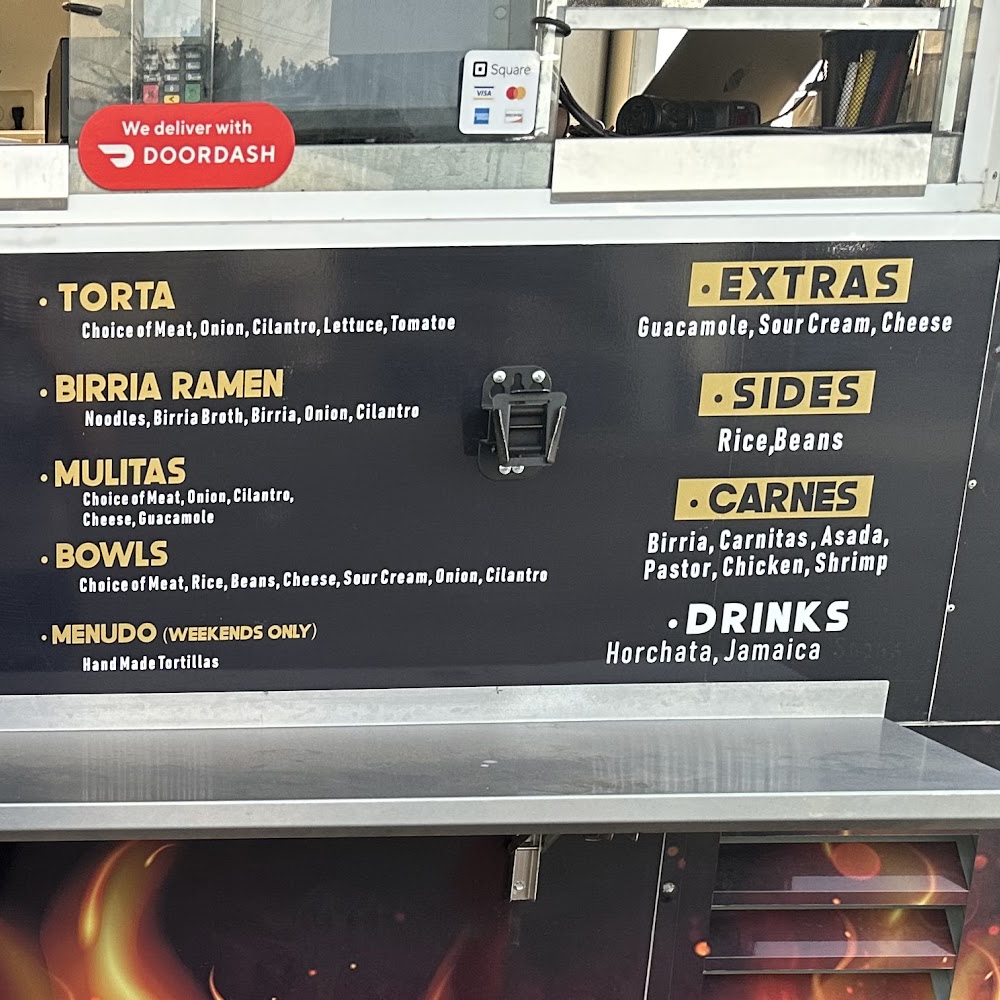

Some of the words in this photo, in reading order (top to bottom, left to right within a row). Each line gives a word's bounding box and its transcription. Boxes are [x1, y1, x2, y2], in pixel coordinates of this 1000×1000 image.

[491, 64, 531, 78] Square
[122, 121, 150, 135] We
[154, 121, 212, 135] deliver
[216, 120, 251, 134] with
[144, 146, 274, 164] DOORDASH
[720, 265, 898, 300] EXTRAS
[59, 281, 175, 311] TORTA
[82, 322, 133, 338] Choice
[137, 321, 152, 338] of
[391, 315, 455, 331] Tomatoe
[759, 314, 804, 334] Sour
[882, 311, 952, 332] Cheese
[56, 373, 161, 402] BIRRIA
[172, 369, 283, 399] RAMEN
[733, 376, 859, 409] SIDES
[154, 409, 198, 425] Birria
[357, 404, 419, 420] Cilantro
[55, 457, 185, 487] MULITAS
[83, 492, 128, 506] Choice
[132, 491, 145, 505] of
[709, 481, 857, 514] CARNES
[139, 509, 214, 525] Guacamole
[56, 541, 167, 568] BOWLS
[815, 552, 887, 576] Shrimp
[80, 577, 128, 592] Choice
[132, 576, 145, 591] of
[344, 570, 377, 585] Sour
[486, 567, 547, 582] Cilantro
[686, 601, 849, 634] DRINKS
[52, 623, 157, 644] MENUDO
[163, 625, 263, 644] (WEEKENDS
[268, 623, 316, 640] ONLY)
[724, 638, 820, 661] Jamaica
[83, 657, 116, 671] Hand
[120, 656, 155, 670] Made
[158, 655, 219, 669] Tortillas
